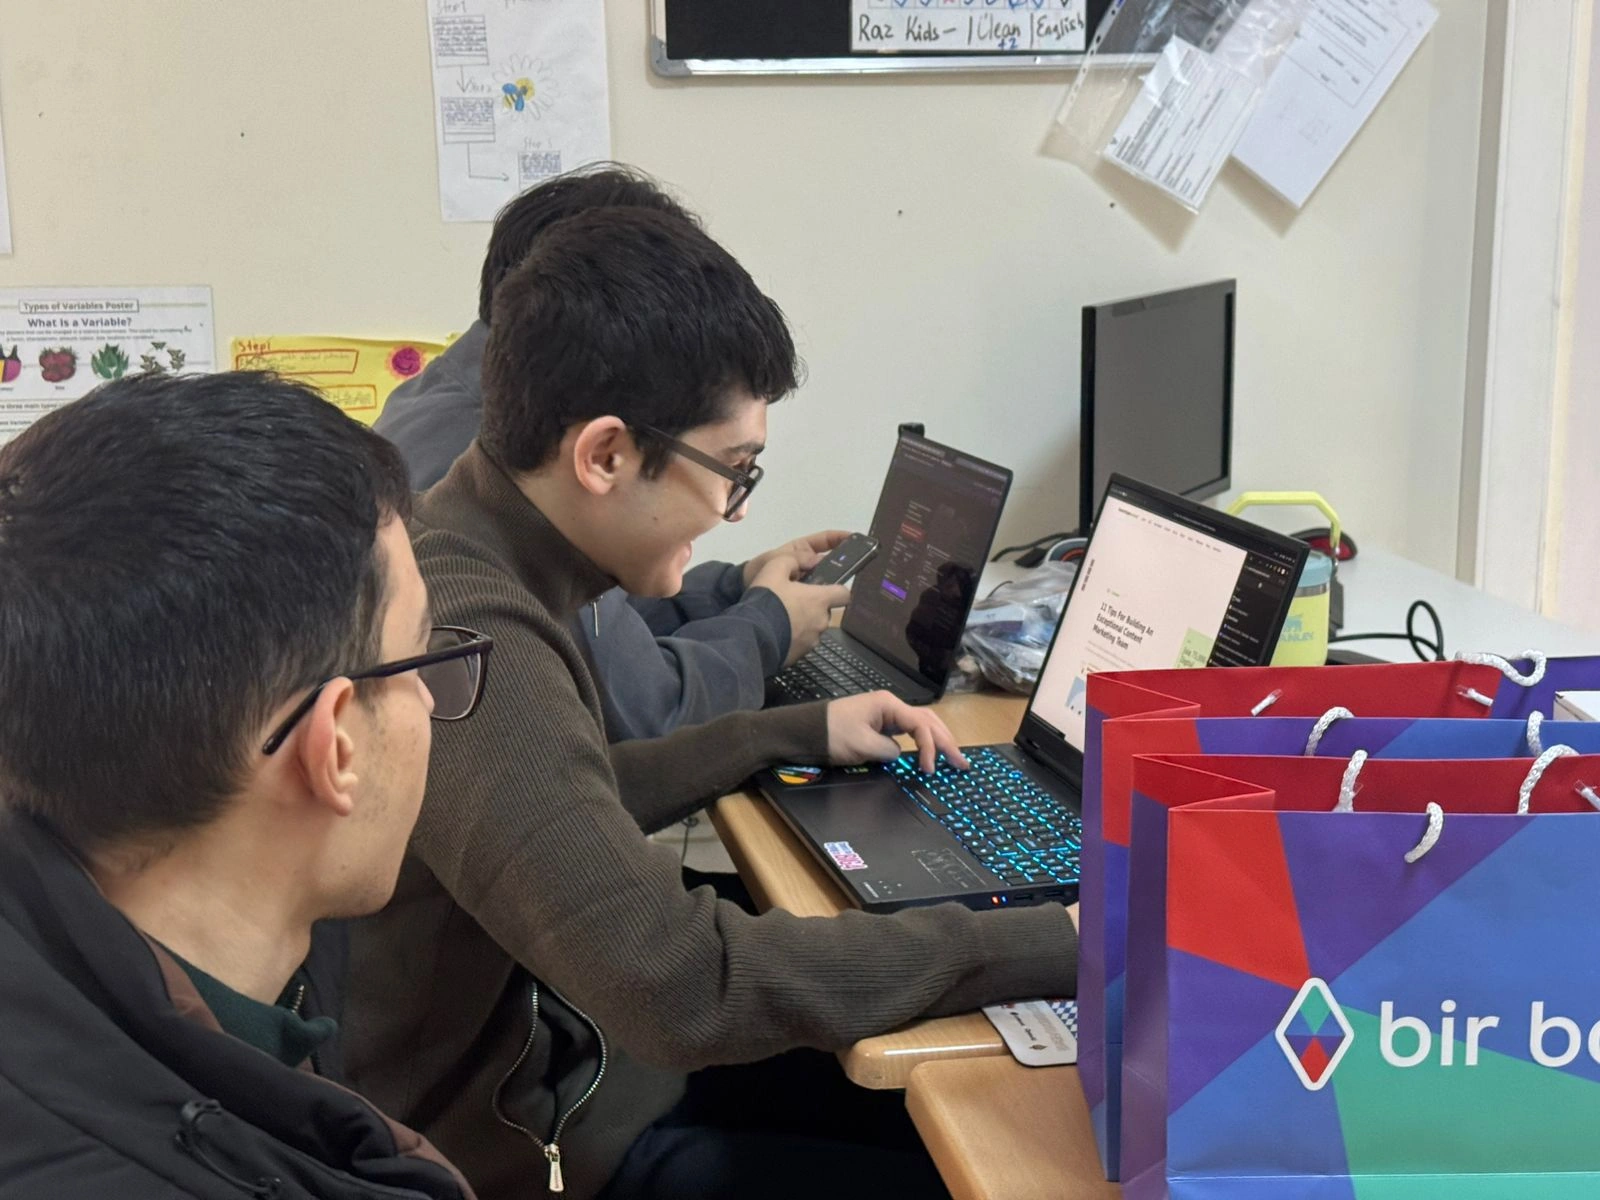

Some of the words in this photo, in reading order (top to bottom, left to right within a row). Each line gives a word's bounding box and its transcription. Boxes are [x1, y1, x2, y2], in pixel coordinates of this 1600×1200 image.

[858, 14, 894, 41] Raz
[906, 15, 940, 42] Kids
[977, 13, 1021, 40] Clean
[1036, 12, 1086, 40] English
[998, 37, 1017, 48] +2
[24, 303, 49, 313] Types
[51, 302, 60, 310] of
[62, 301, 104, 310] Variables
[105, 301, 134, 309] Poster
[28, 318, 57, 328] What
[81, 317, 132, 327] Variable?
[1096, 613, 1124, 633] Exceptional
[1123, 628, 1143, 644] Content
[1117, 611, 1126, 621] For
[1126, 616, 1146, 634] Building
[1093, 624, 1116, 644] Marketing
[1116, 636, 1129, 650] Team
[1380, 1000, 1500, 1067] bir
[1529, 1000, 1600, 1068] b
